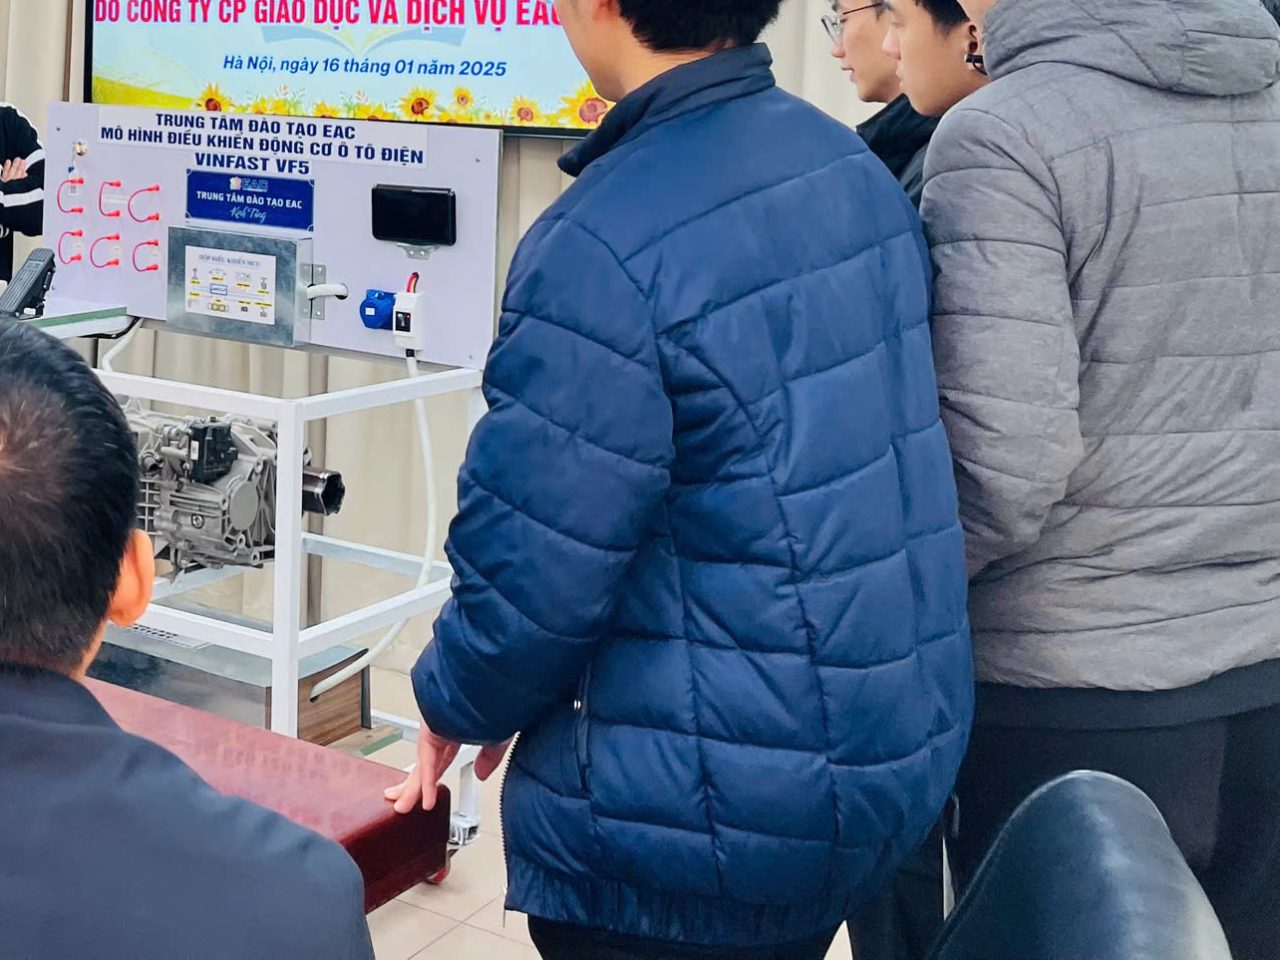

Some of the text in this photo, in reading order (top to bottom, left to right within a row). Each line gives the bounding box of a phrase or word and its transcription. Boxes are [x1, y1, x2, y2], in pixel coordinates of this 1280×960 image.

[223, 55, 507, 77] Hà Nội, ngày 16 tháng 01 năm 2025
[156, 113, 356, 140] TRUNG TÂM ĐÀO TẠO EAC
[101, 125, 123, 141] MÔ
[128, 126, 163, 144] HÌNH
[207, 132, 254, 152] KHIỂN
[259, 136, 304, 156] ĐỘNG
[310, 142, 333, 157] CƠ
[338, 141, 349, 158] Ô
[354, 143, 376, 160] TÔ
[381, 146, 424, 166] ĐIỆN
[195, 152, 310, 175] VINFAST VF5
[196, 191, 302, 209] TRUNG TÂM ĐÀO TẠO EAC
